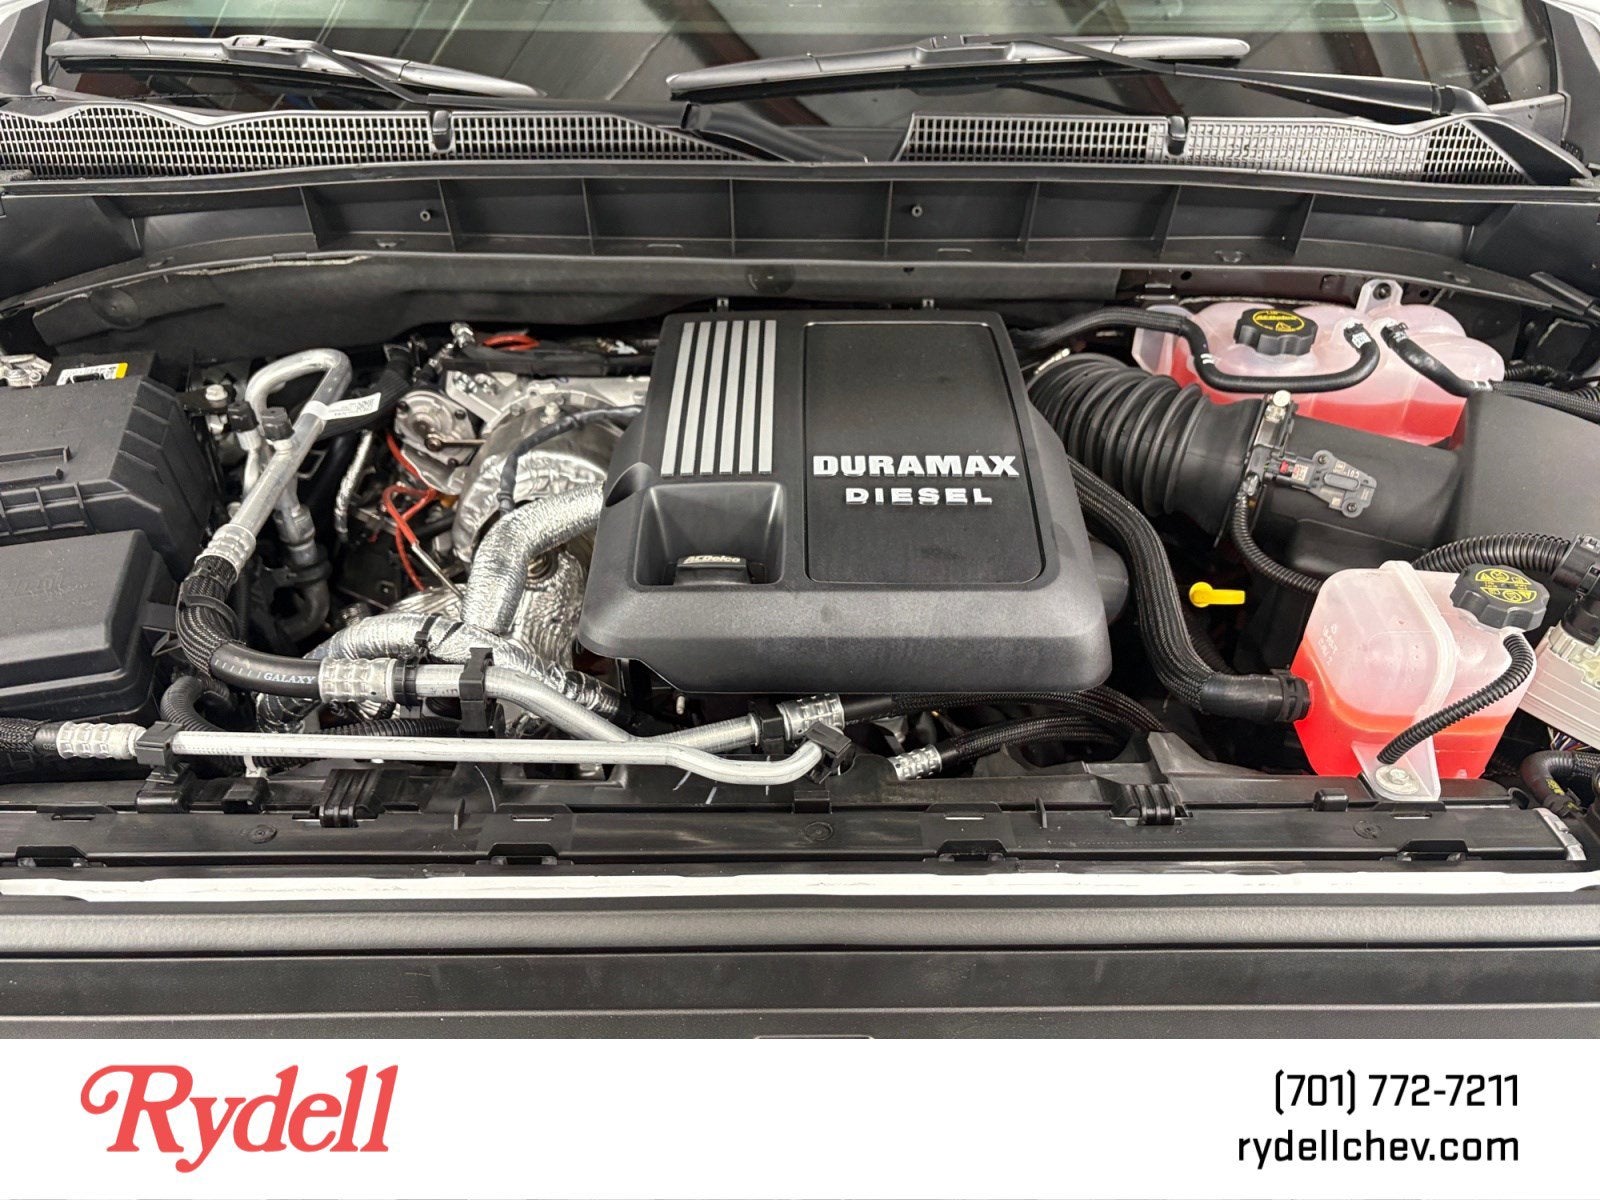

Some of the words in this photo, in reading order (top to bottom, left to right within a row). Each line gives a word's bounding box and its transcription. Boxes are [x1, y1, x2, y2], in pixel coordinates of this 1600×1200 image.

[813, 455, 1020, 478] DURAMAX
[846, 488, 992, 506] DIESEL
[682, 555, 741, 564] ACDelco
[263, 672, 316, 684] GALAXY
